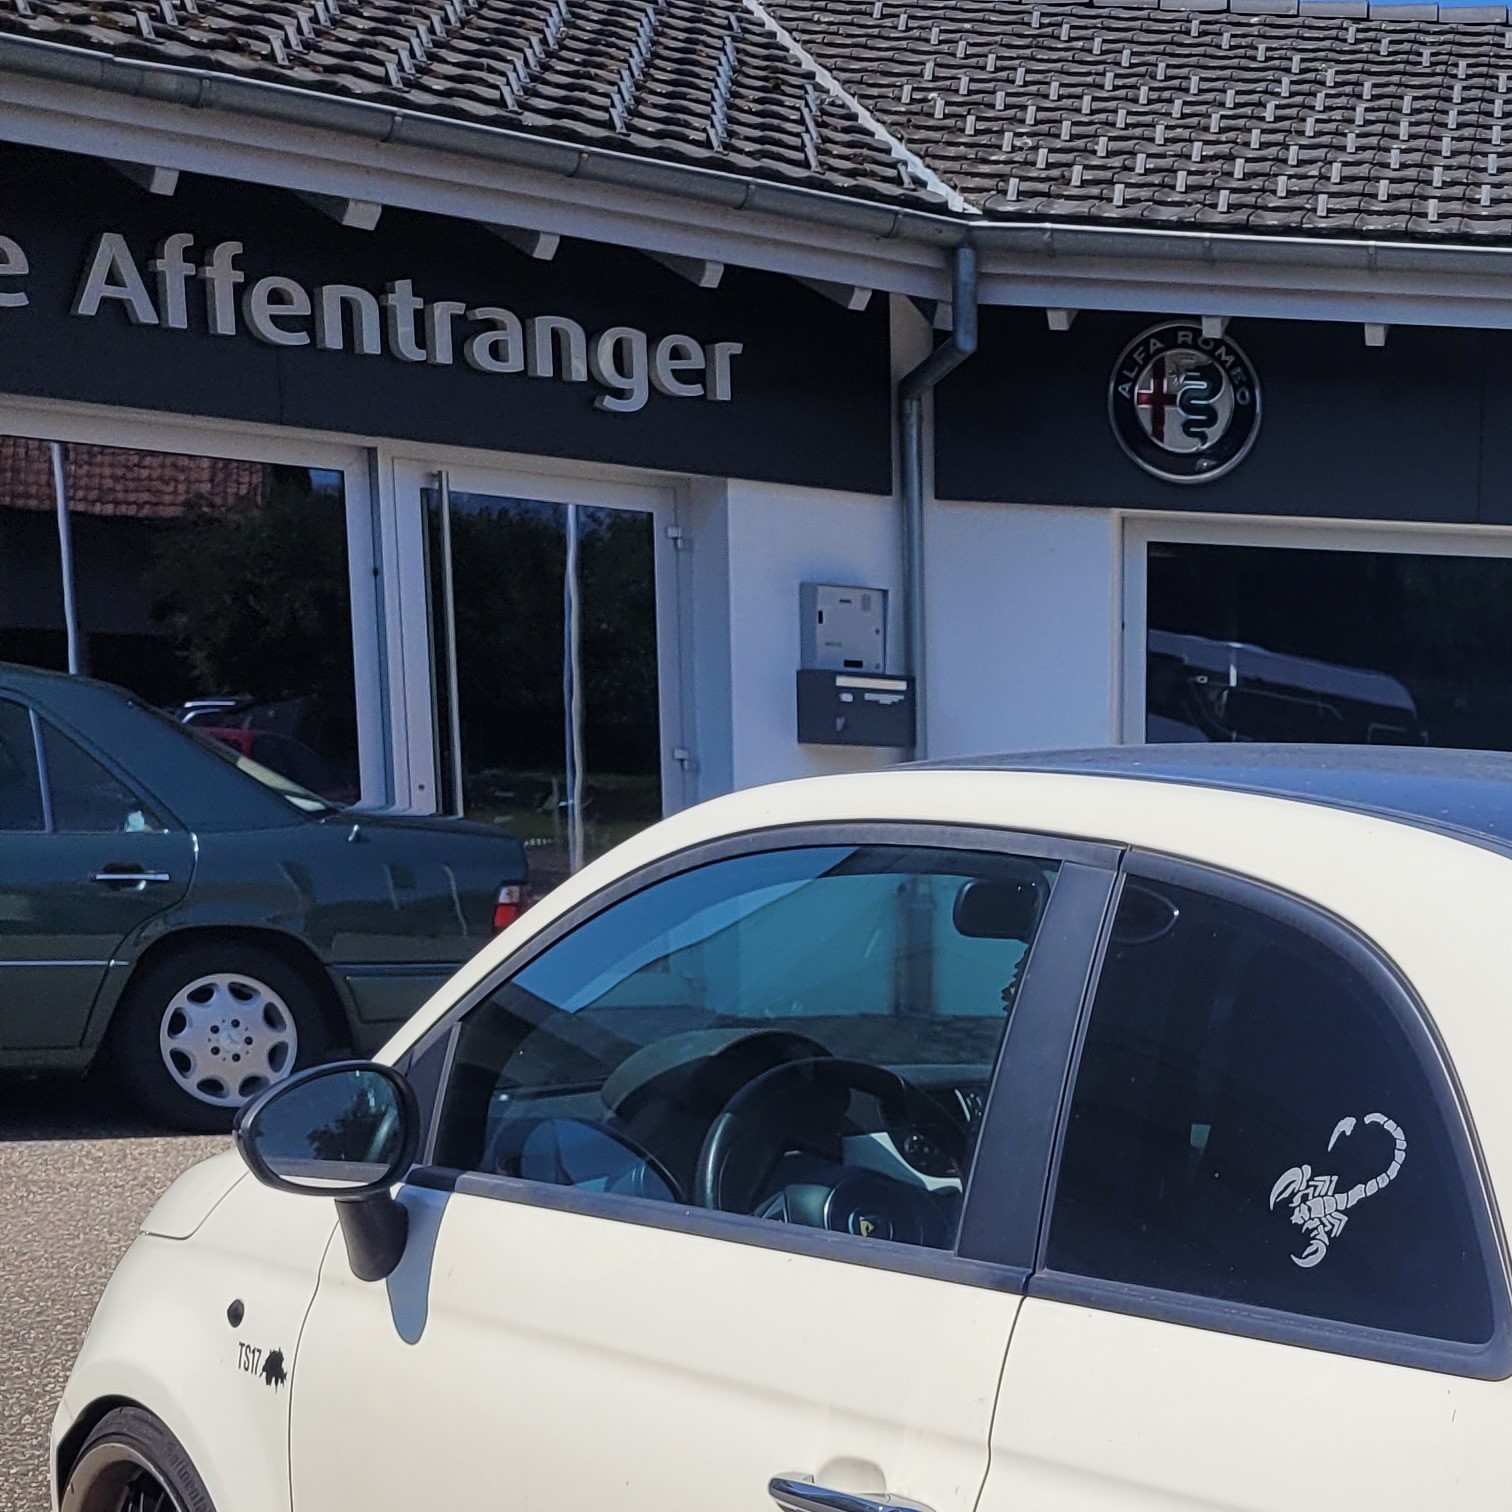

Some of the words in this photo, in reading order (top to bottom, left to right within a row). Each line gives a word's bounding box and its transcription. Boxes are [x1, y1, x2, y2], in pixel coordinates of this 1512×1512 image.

[73, 232, 743, 412] Affentranger
[1118, 337, 1165, 399] ALFA
[1177, 331, 1250, 405] ROMEO
